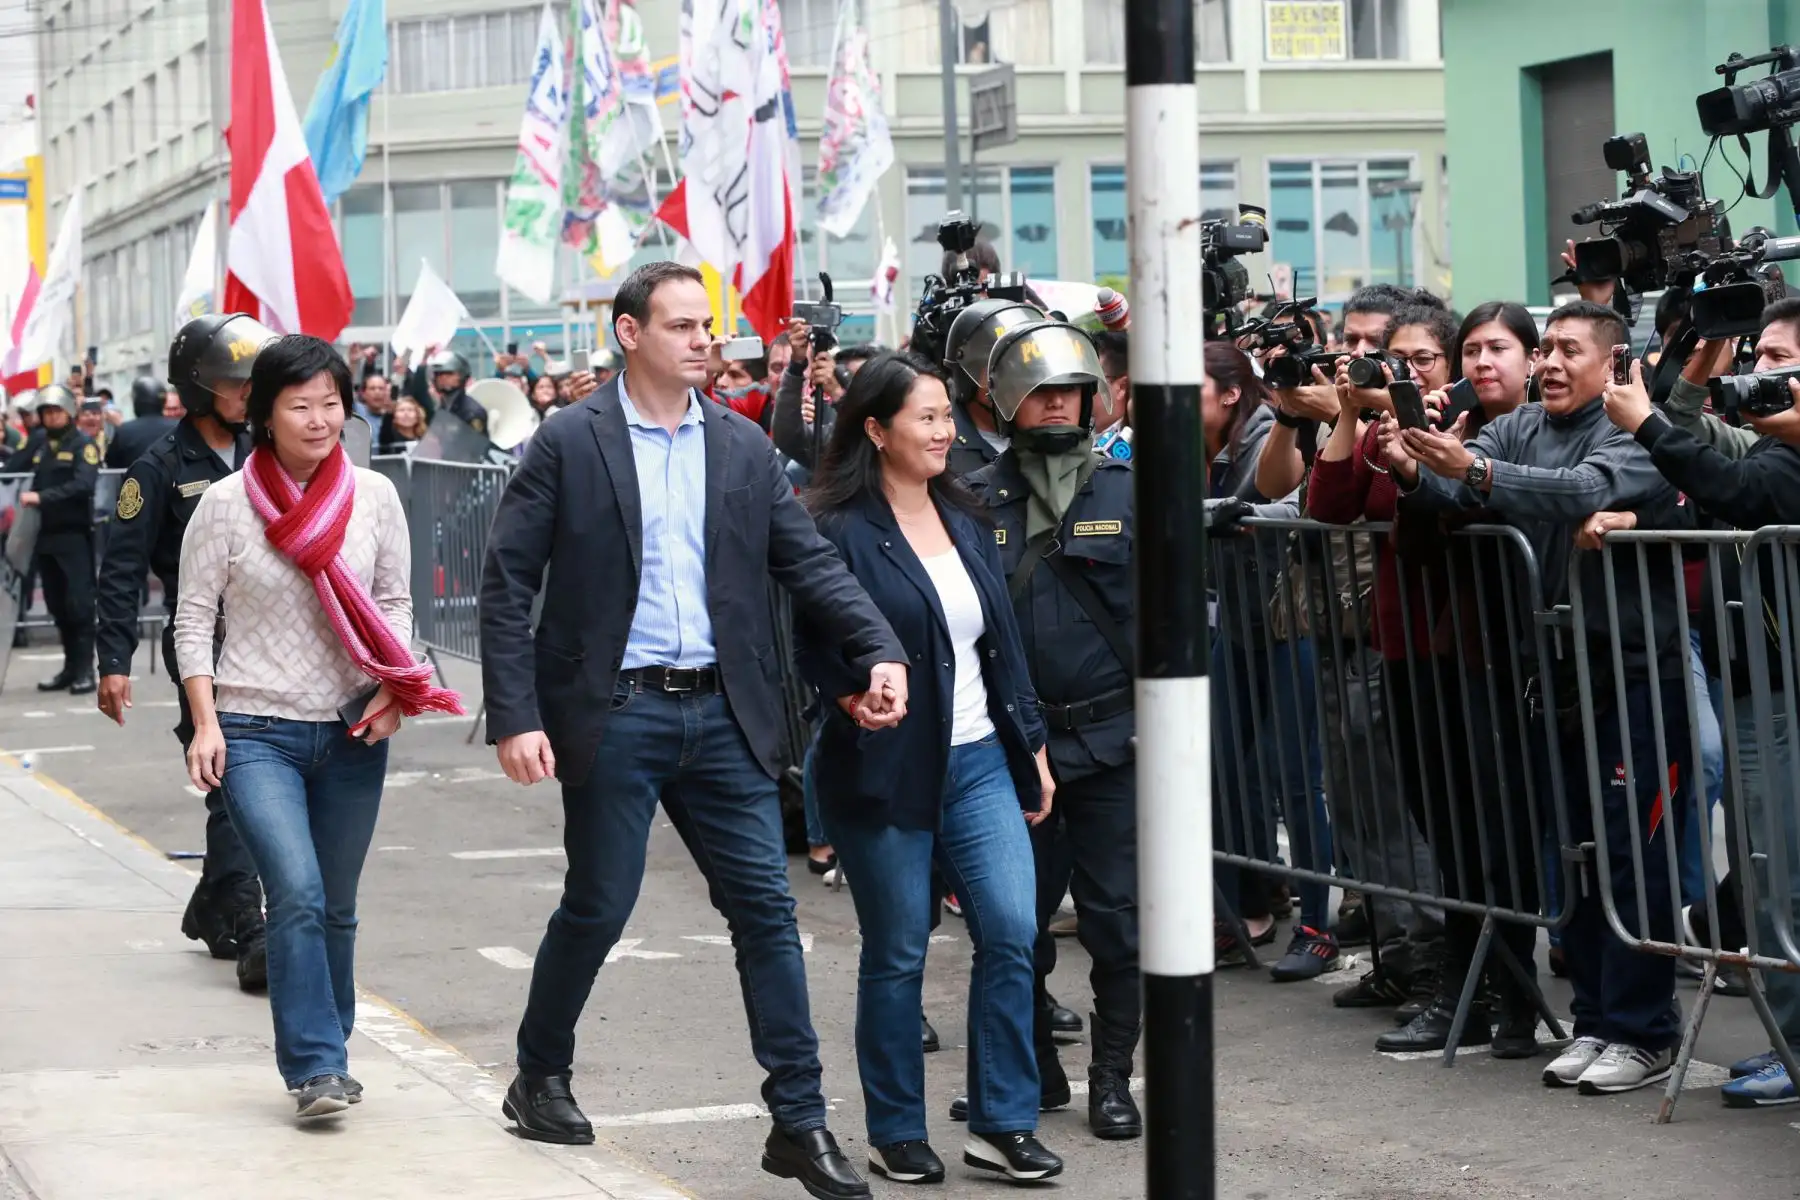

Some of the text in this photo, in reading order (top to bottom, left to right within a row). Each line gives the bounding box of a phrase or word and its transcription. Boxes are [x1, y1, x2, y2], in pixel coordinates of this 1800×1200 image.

[1270, 6, 1340, 22] SE VENDE
[1076, 523, 1118, 532] POLICIA NACIONAL
